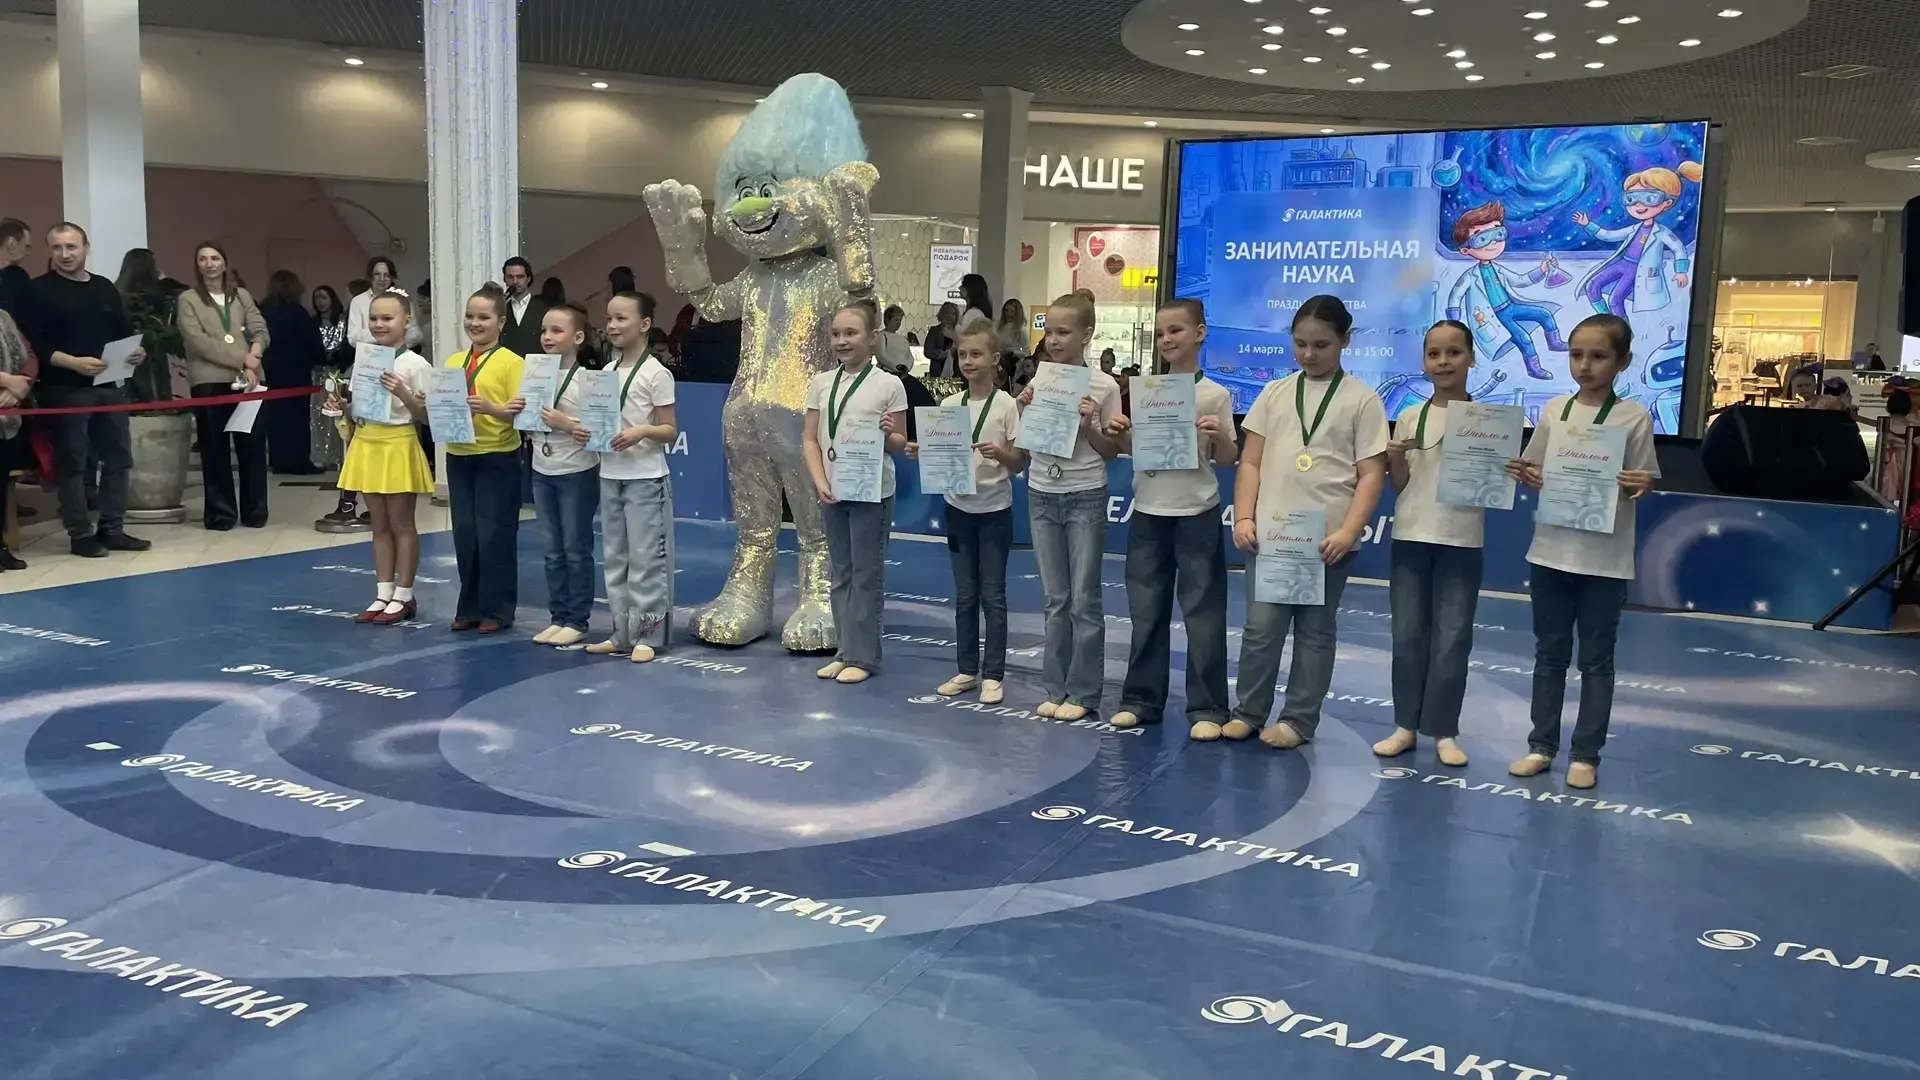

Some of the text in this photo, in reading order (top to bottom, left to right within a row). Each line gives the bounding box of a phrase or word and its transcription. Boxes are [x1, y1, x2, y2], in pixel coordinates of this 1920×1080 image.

[1023, 154, 1145, 190] НАШЕ
[1296, 208, 1363, 220] ГАЛАКТИКА
[1225, 240, 1420, 260] ЗАНИМАТЕЛЬНАЯ
[1282, 265, 1355, 284] НАУКА
[1267, 300, 1367, 310] ПРАЗД СТВА
[1238, 343, 1284, 356] 14 марта
[1364, 346, 1394, 357] 15:00
[1723, 651, 1918, 676] ГАЛАКТИКА
[253, 669, 417, 699] ГАЛАКТИКА
[608, 730, 814, 771] ГАЛАКТИКА
[158, 762, 365, 812] ГАЛАКТИКА
[1421, 774, 1693, 826] ГАЛАКТИКА
[1083, 815, 1360, 878] ГАЛАКТИКА
[609, 861, 887, 933] ГАЛАКТИКА
[27, 932, 308, 1028] ГАЛАКТИКА
[1277, 1014, 1568, 1080] ГАЛАКТ
